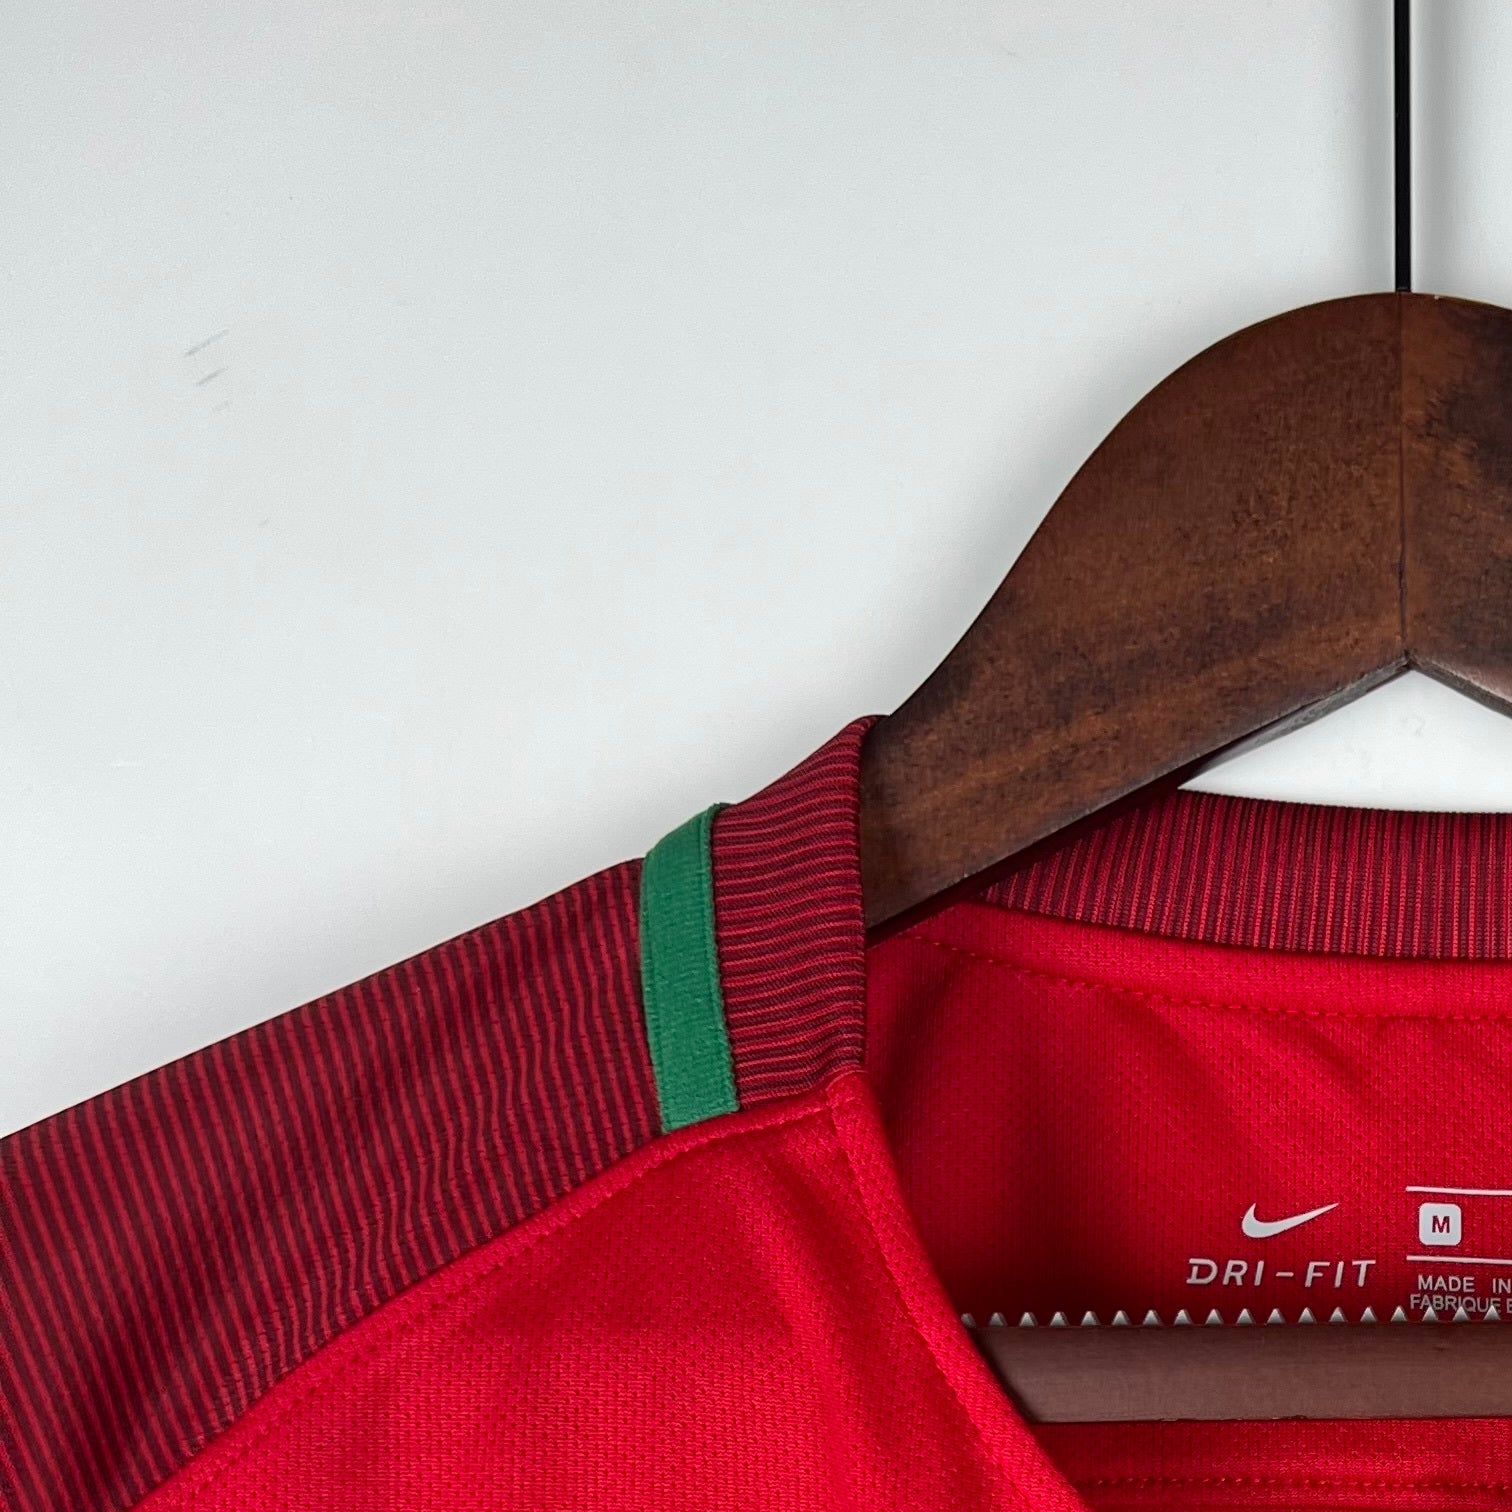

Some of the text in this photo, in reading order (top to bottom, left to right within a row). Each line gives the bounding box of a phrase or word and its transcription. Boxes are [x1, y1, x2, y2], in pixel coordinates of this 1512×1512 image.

[1431, 1215, 1450, 1233] M
[1418, 1275, 1475, 1292] MADE
[1493, 1278, 1511, 1294] IN
[1410, 1294, 1501, 1314] FABRIQUE
